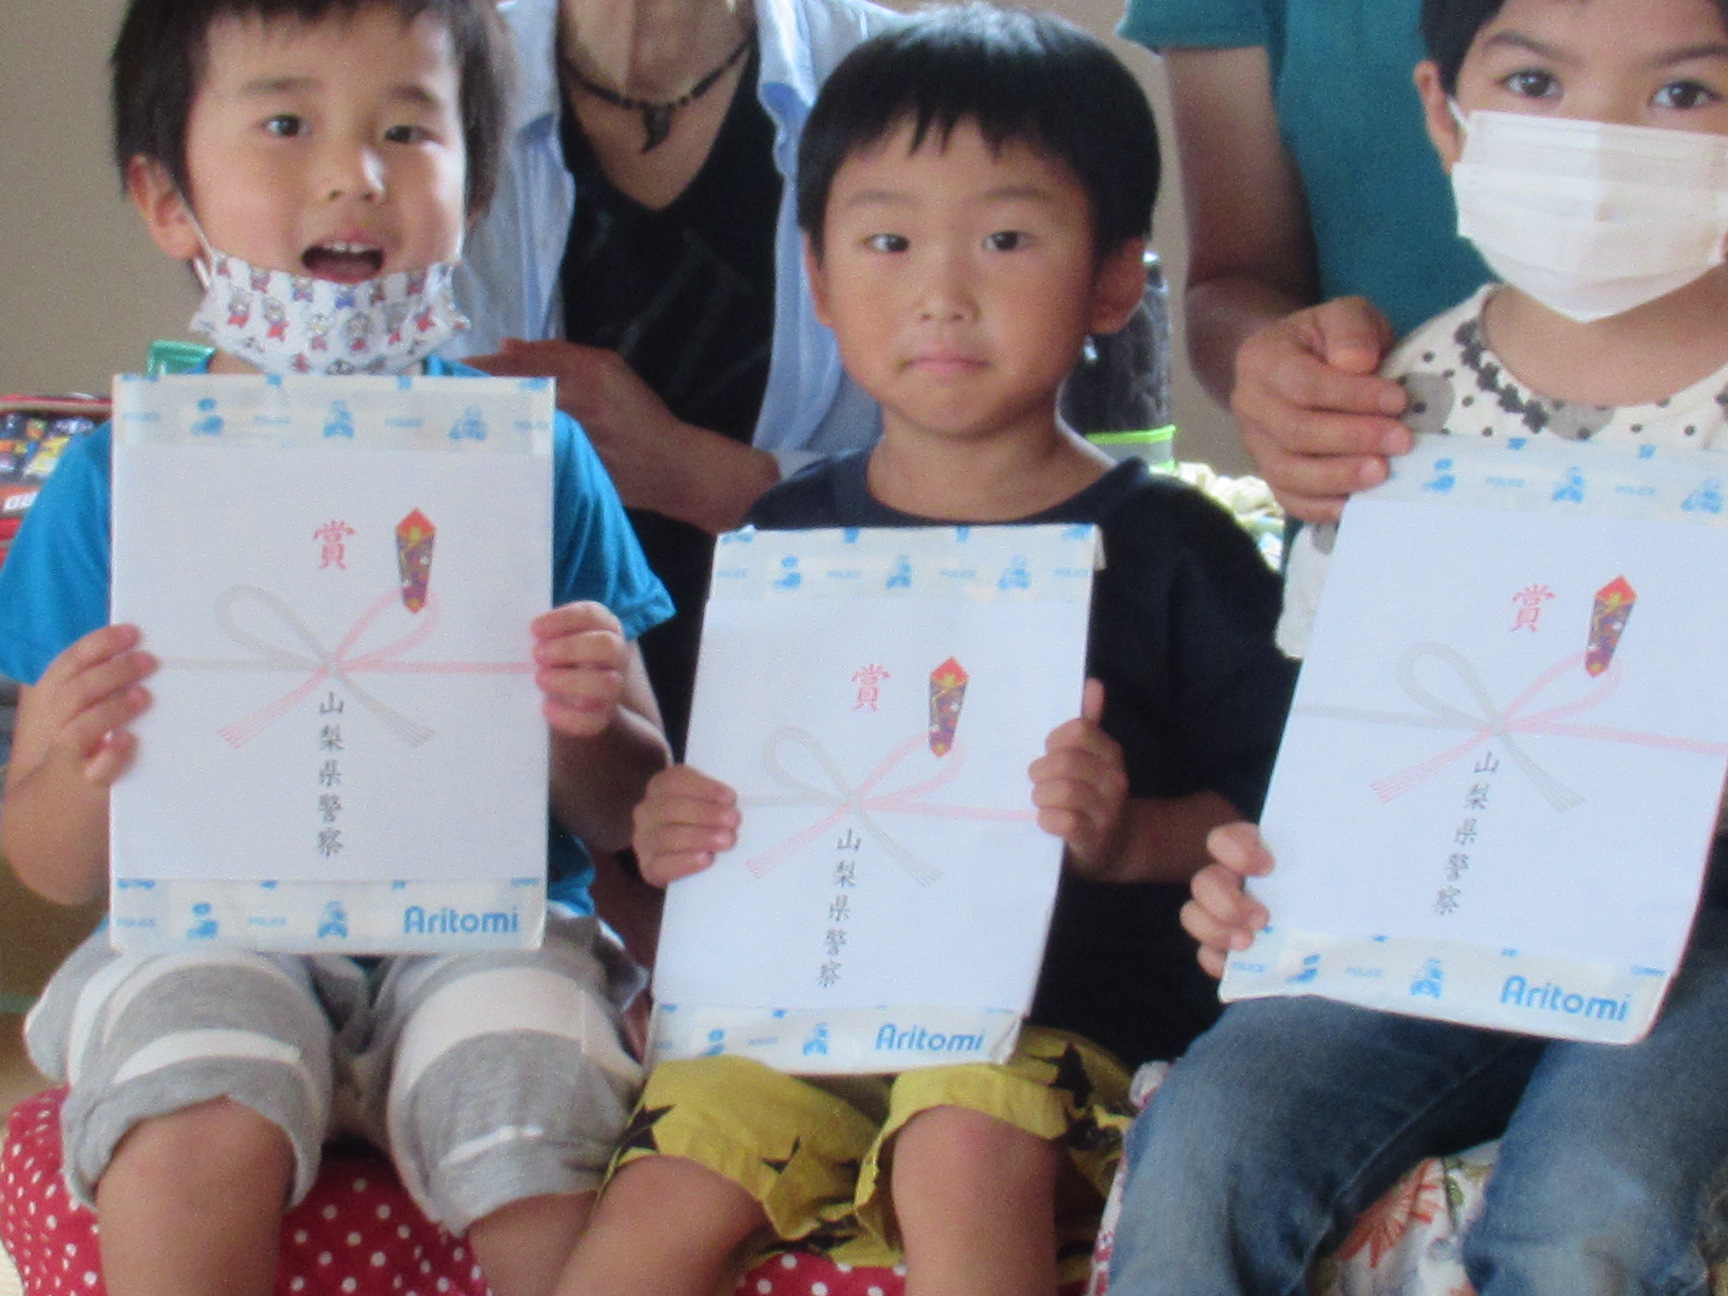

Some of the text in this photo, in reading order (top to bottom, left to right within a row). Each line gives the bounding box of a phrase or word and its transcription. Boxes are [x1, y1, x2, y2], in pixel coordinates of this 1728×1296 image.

[313, 518, 357, 571] 賞
[1509, 582, 1556, 634] 賞
[851, 661, 893, 712] 賞
[318, 690, 346, 860] 山梨県警察
[1432, 750, 1501, 916] 山梨県警察
[402, 905, 520, 935] Aritomi
[817, 827, 863, 988] 山梨県警察
[1499, 974, 1631, 1023] Aritomi
[874, 1023, 987, 1053] Aritomi
